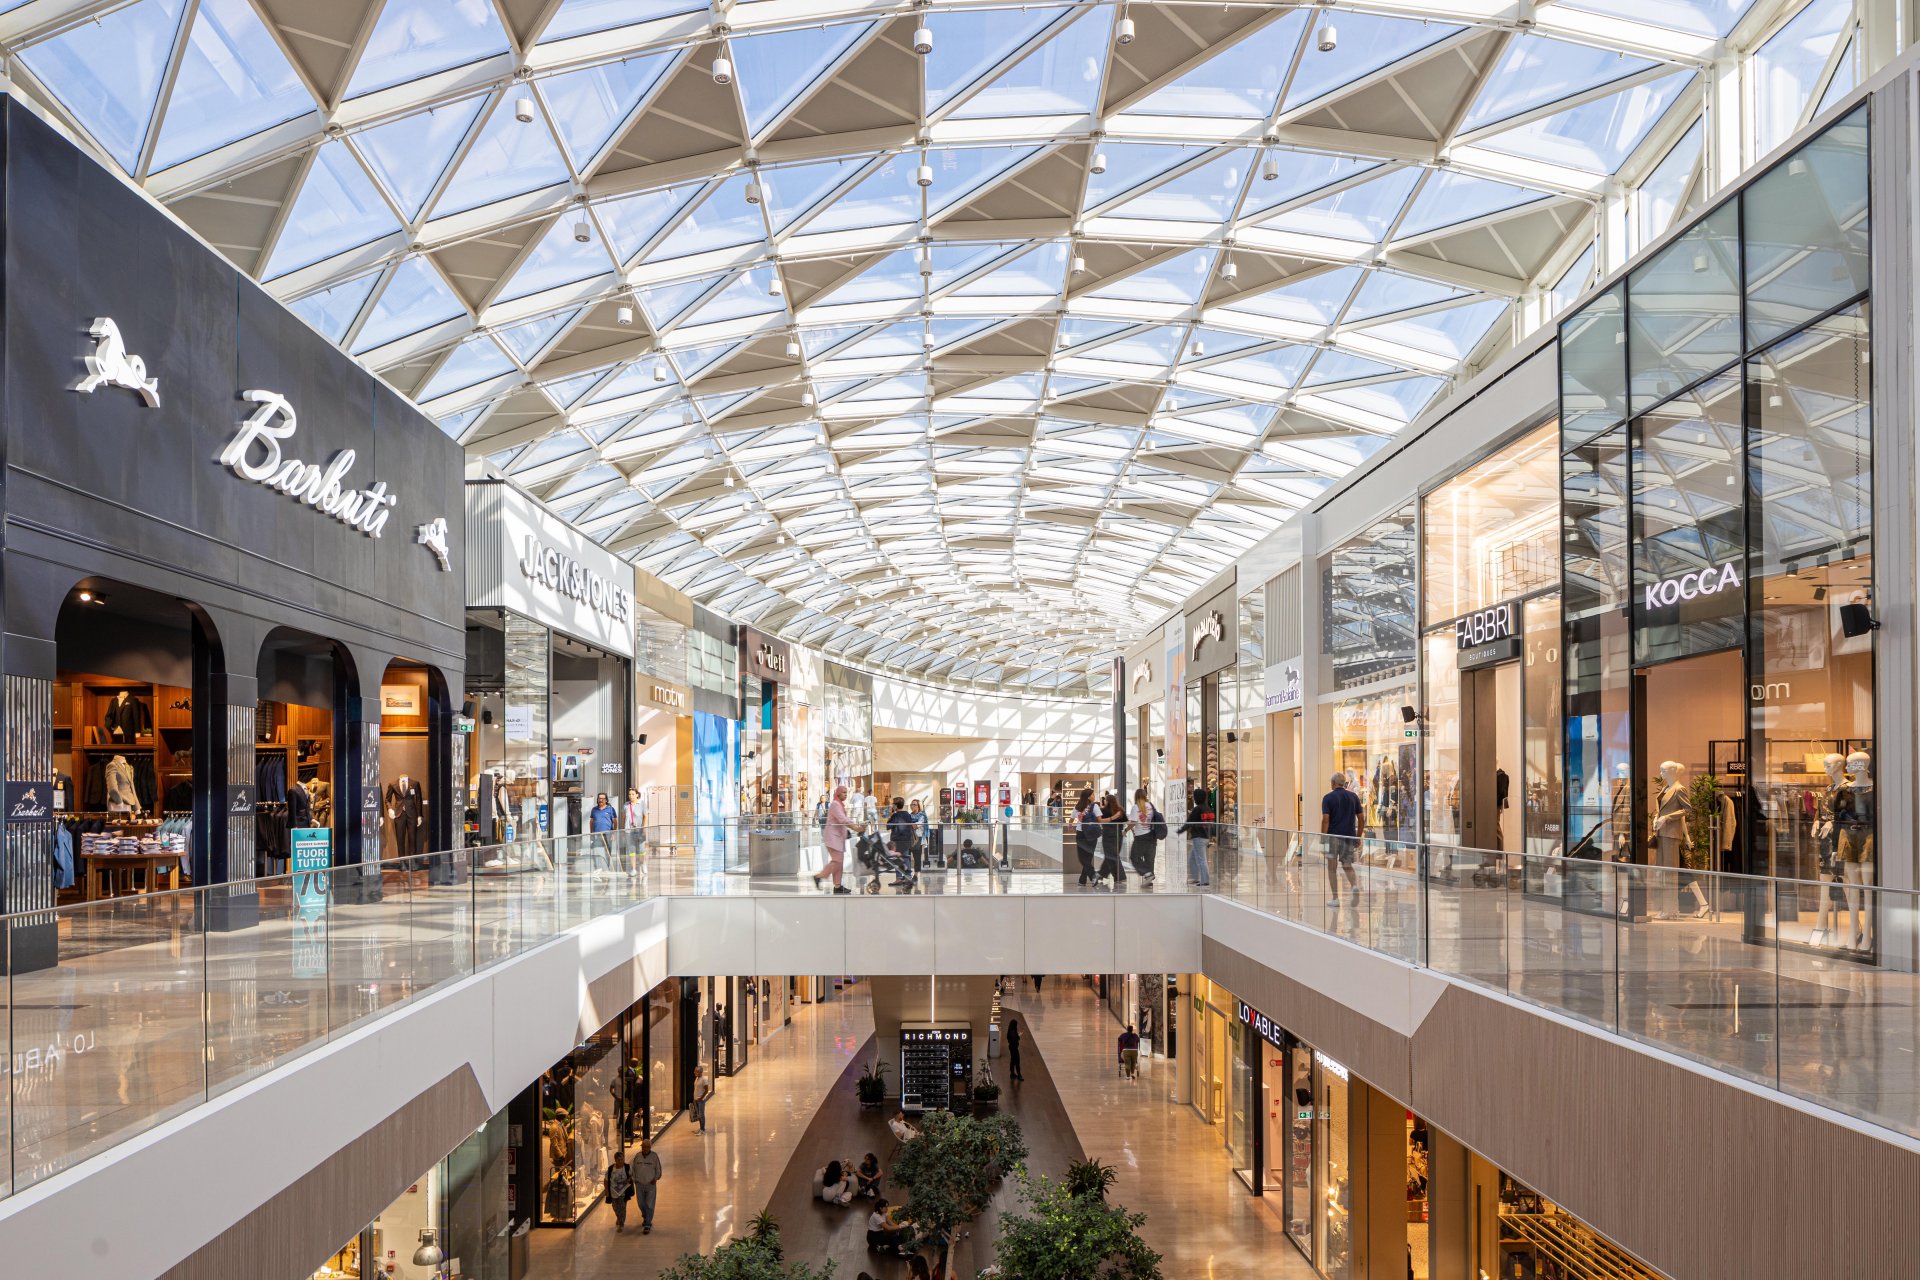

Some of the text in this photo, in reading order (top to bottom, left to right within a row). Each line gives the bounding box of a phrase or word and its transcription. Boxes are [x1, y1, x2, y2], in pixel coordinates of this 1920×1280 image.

[220, 389, 397, 539] Barbuti
[1645, 562, 1741, 611] KOCCA
[1455, 602, 1511, 651] FABBRI
[1469, 648, 1497, 661] BOUTIQUES
[653, 685, 685, 709] motivi
[11, 803, 47, 817] Barbuti
[1544, 824, 1560, 832] FABBRI
[297, 848, 328, 859] FUORI
[297, 858, 328, 868] TUTTO
[1238, 1000, 1281, 1046] LOVABLE
